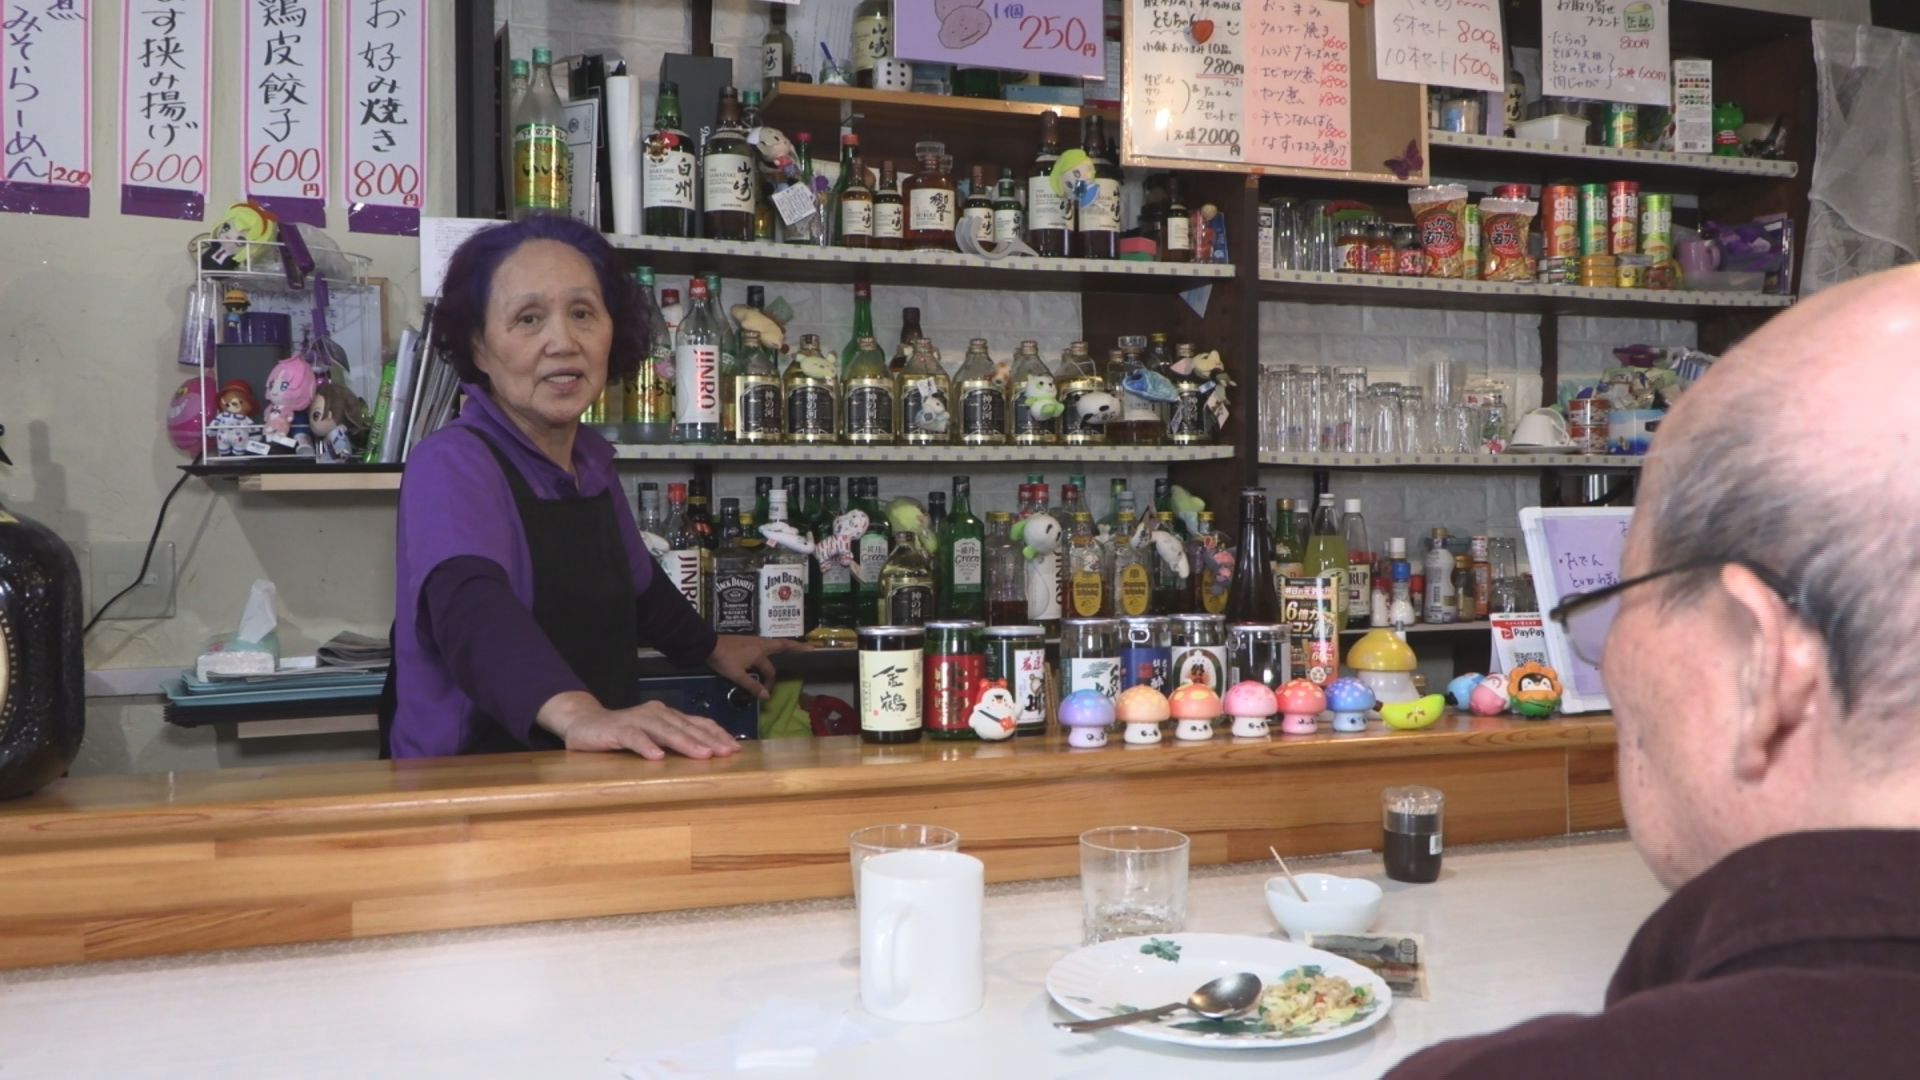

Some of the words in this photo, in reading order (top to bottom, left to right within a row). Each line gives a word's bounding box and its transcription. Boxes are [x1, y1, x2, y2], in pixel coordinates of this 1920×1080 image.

[994, 3, 1024, 18] 1個
[1019, 15, 1097, 57] 250円
[3, 5, 50, 179] みそらーめん
[137, 0, 199, 148] す挟み揚げ
[258, 0, 308, 143] 鶏皮餃子
[358, 0, 408, 153] お好み焼き
[130, 149, 204, 184] 600
[675, 157, 693, 202] 白州
[733, 161, 753, 202] 山崎
[693, 349, 716, 410] JINRO
[764, 575, 781, 591] JIM
[1513, 627, 1545, 639] PayPay
